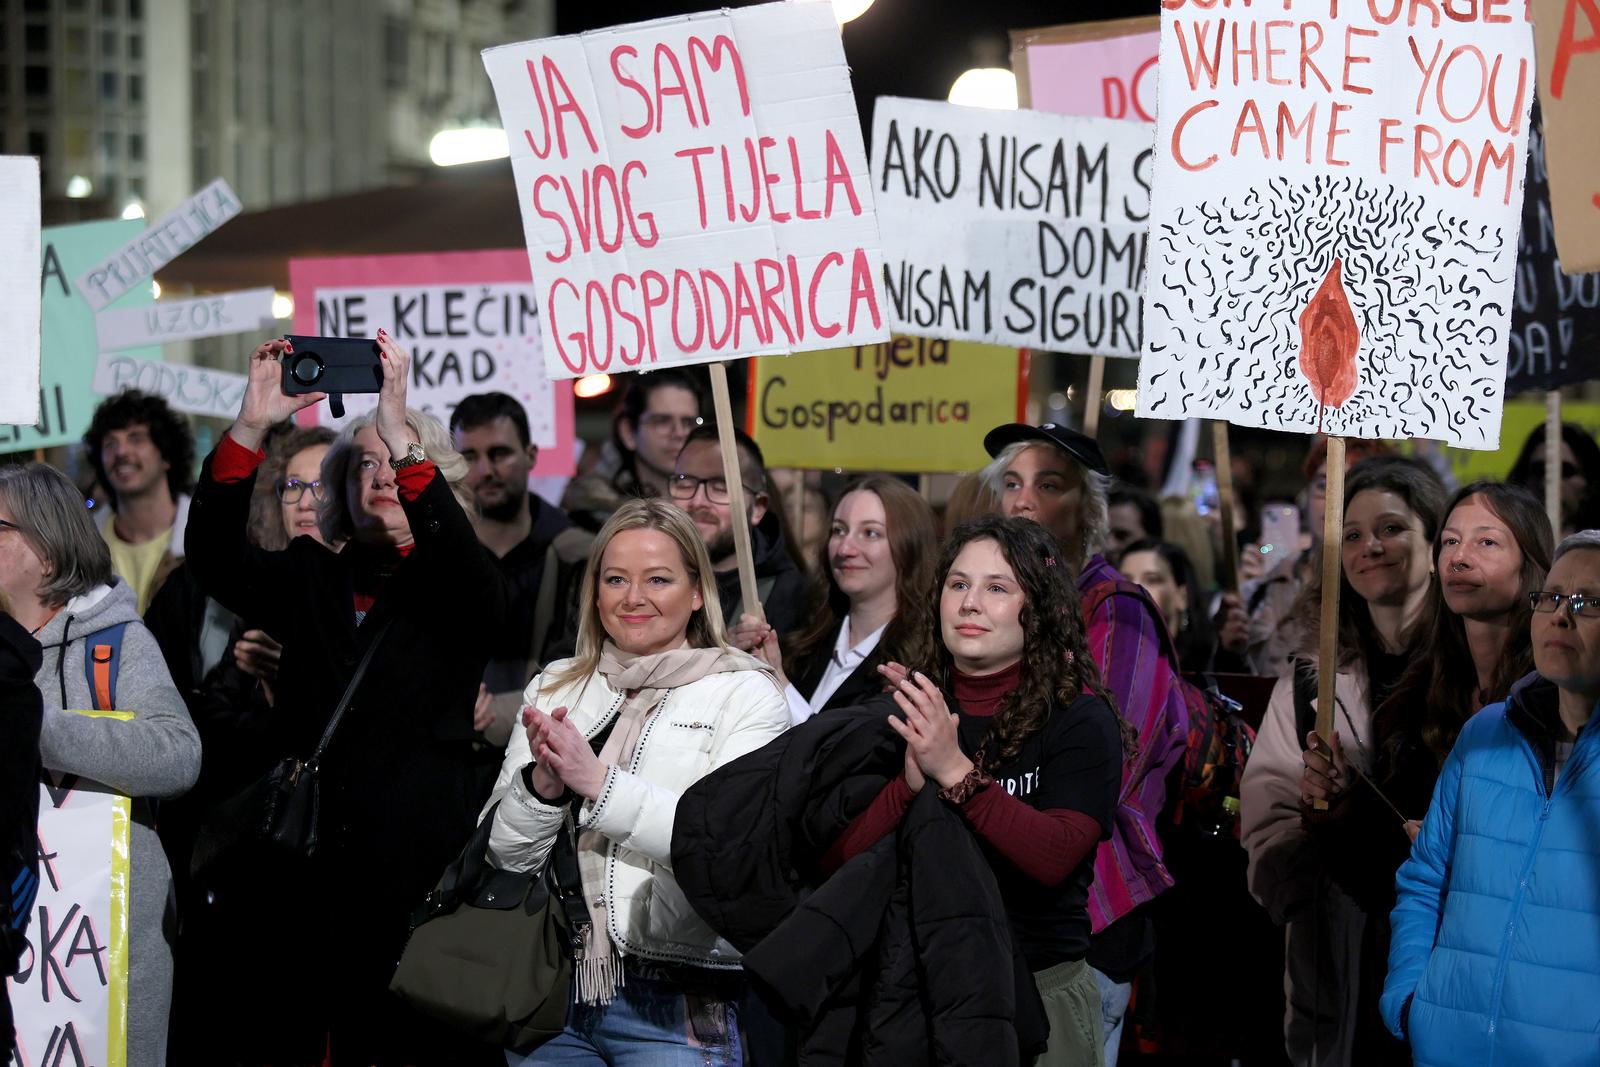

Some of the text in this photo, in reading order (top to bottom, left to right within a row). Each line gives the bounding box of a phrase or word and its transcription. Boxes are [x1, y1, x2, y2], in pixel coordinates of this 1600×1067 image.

[525, 34, 750, 159] JA SAM
[1173, 18, 1527, 136] WHERE YOU
[533, 129, 862, 264] SVOG TIJELA
[882, 119, 962, 202] AKO
[979, 132, 1109, 223] NISAM
[1171, 99, 1352, 172] CAME
[1379, 118, 1515, 205] FROM
[144, 300, 232, 336] UZOR
[316, 296, 368, 338] NE
[549, 248, 881, 374] GOSPODARICA
[883, 261, 992, 333] NISAM
[411, 348, 497, 389] KAD
[761, 376, 971, 443] Gospodarica
